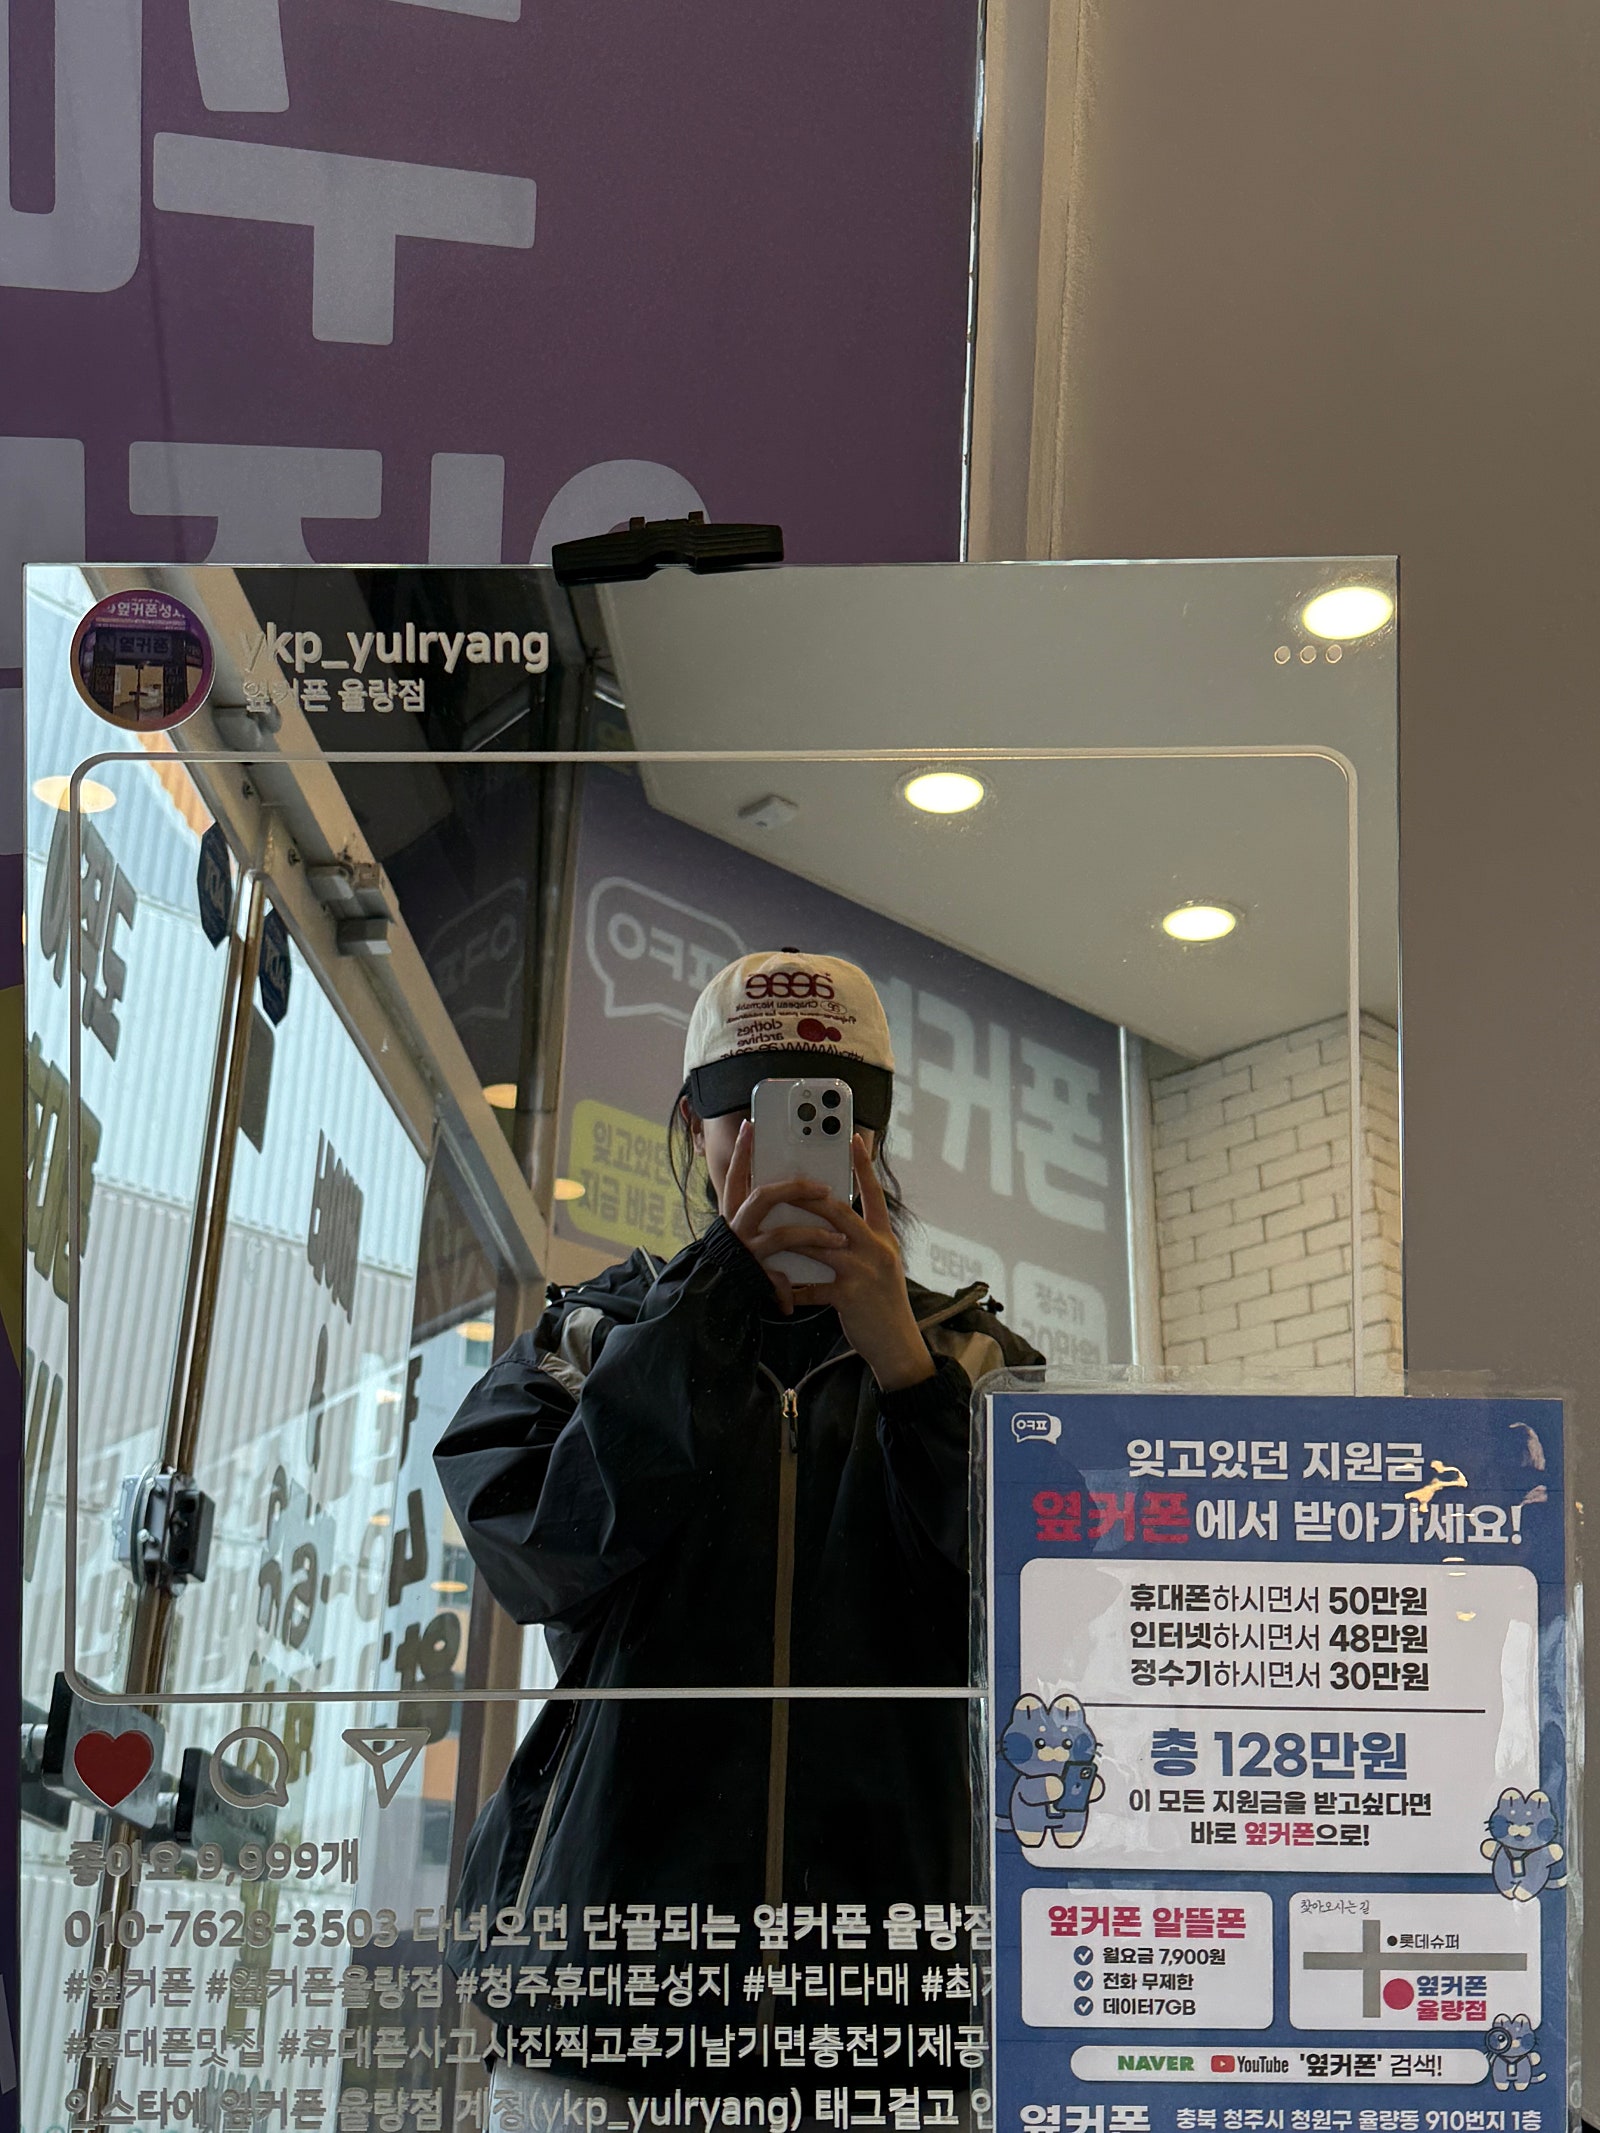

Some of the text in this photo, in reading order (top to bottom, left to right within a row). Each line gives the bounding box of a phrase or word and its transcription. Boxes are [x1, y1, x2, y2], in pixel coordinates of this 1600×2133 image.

[240, 622, 549, 675] ykp_yulryang
[338, 678, 426, 713] 율량점
[1126, 1439, 1424, 1483] 잊고있던 지원금
[1033, 1490, 1522, 1546] 옆커폰에서 받아가세요!
[1130, 1584, 1428, 1616] 휴대폰하시면서 50만원
[1130, 1621, 1428, 1654] 인터넷하시면서 48만원
[1130, 1658, 1430, 1692] 정수기하시면서 30만원
[1150, 1728, 1407, 1781] 총 128만원
[1128, 1790, 1432, 1816] 이 모든 지원금을 받고싶다면
[1190, 1822, 1370, 1847] 바로 옆커폰으로!
[65, 1838, 360, 1887] 좋아요 9,999개
[1048, 1905, 1247, 1939] 옆커폰 알뜰폰
[1300, 1899, 1370, 1915] 찾아오시는 길
[64, 1902, 993, 1953] 010-7628-3503 다녀오면 단골되는 옆커폰 율량점
[1399, 1933, 1460, 1950] 롯데슈퍼
[1102, 1947, 1225, 1967] 월요금 7,900원
[64, 1965, 194, 2008] #옆커폰
[204, 1964, 444, 2010] #옆커폰율량점
[455, 1963, 731, 2008] #청주휴대폰성지
[742, 1962, 910, 2006] #박리다매
[1102, 1972, 1193, 1990] 전화 무제한
[1416, 1975, 1487, 1997] 옆커폰
[1102, 1996, 1196, 2017] 데이터7GB
[1416, 1999, 1487, 2022] 율량점
[64, 2024, 265, 2069] #휴대폰맛집
[1118, 2055, 1194, 2072] NAVER
[1238, 2056, 1289, 2074] YouTube
[1390, 2053, 1442, 2078] 검색!
[64, 2087, 208, 2132] 인스타에
[220, 2087, 327, 2129] 옆커폰
[336, 2087, 444, 2132] 율량점
[815, 2087, 960, 2132] 태그걸고
[1020, 2105, 1151, 2133] 옆커폰
[1176, 2109, 1542, 2133] 충북 청주시 청원구 율량동 910번지 1층
